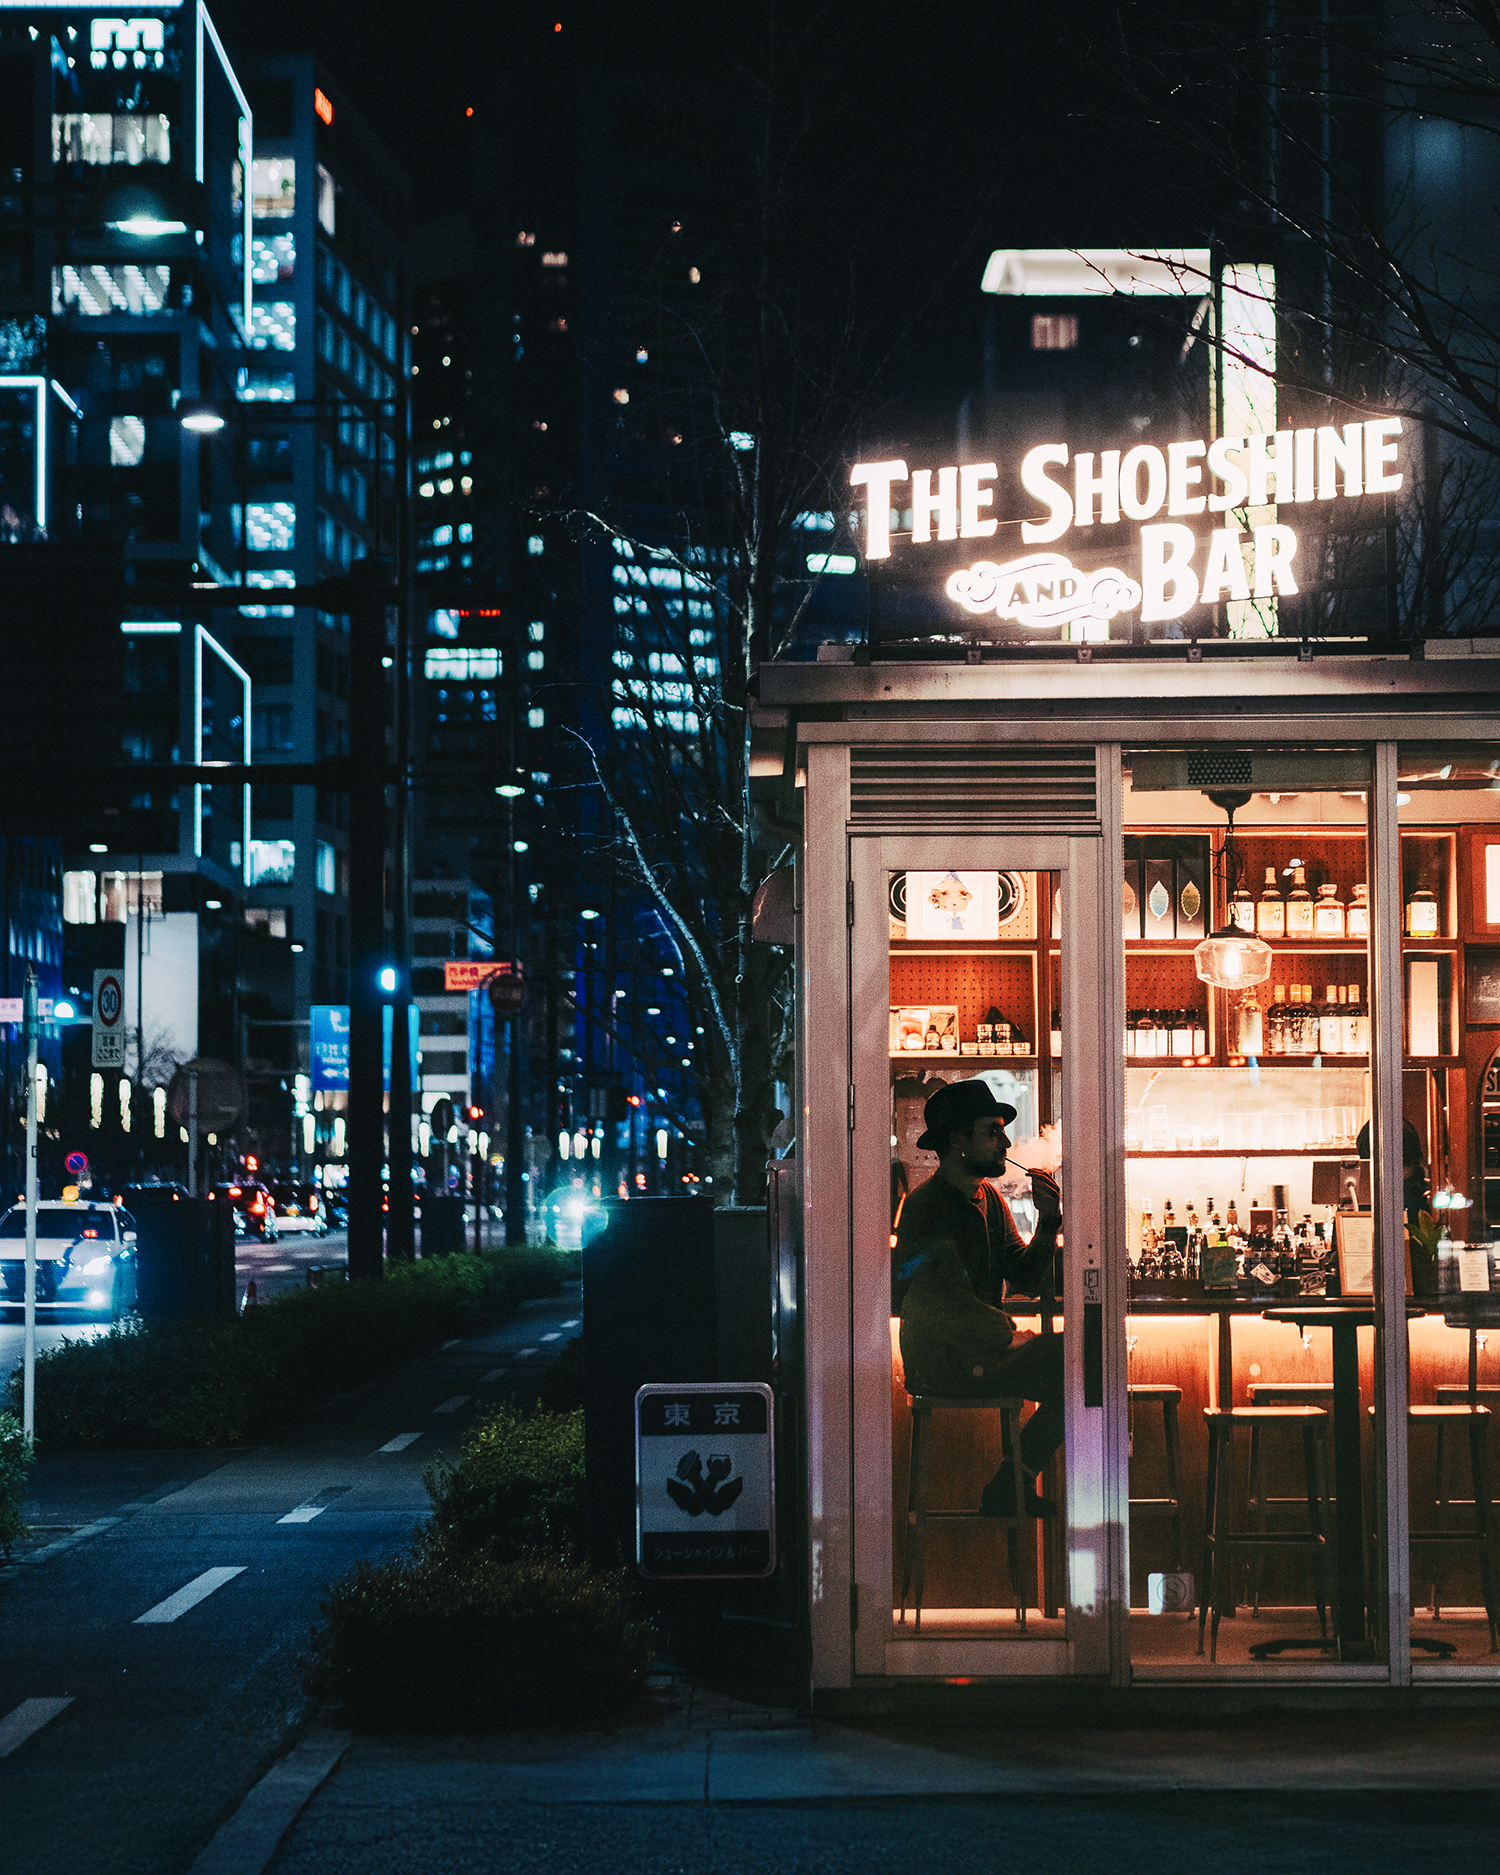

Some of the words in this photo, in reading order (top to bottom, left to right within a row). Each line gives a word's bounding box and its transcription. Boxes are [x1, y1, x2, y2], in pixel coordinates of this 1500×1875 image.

[849, 459, 999, 560] THE
[1021, 417, 1405, 545] SHOESHINE
[1007, 578, 1078, 607] AND
[1140, 523, 1300, 622] BAR
[102, 990, 117, 1013] 30
[663, 1402, 741, 1427] 東京
